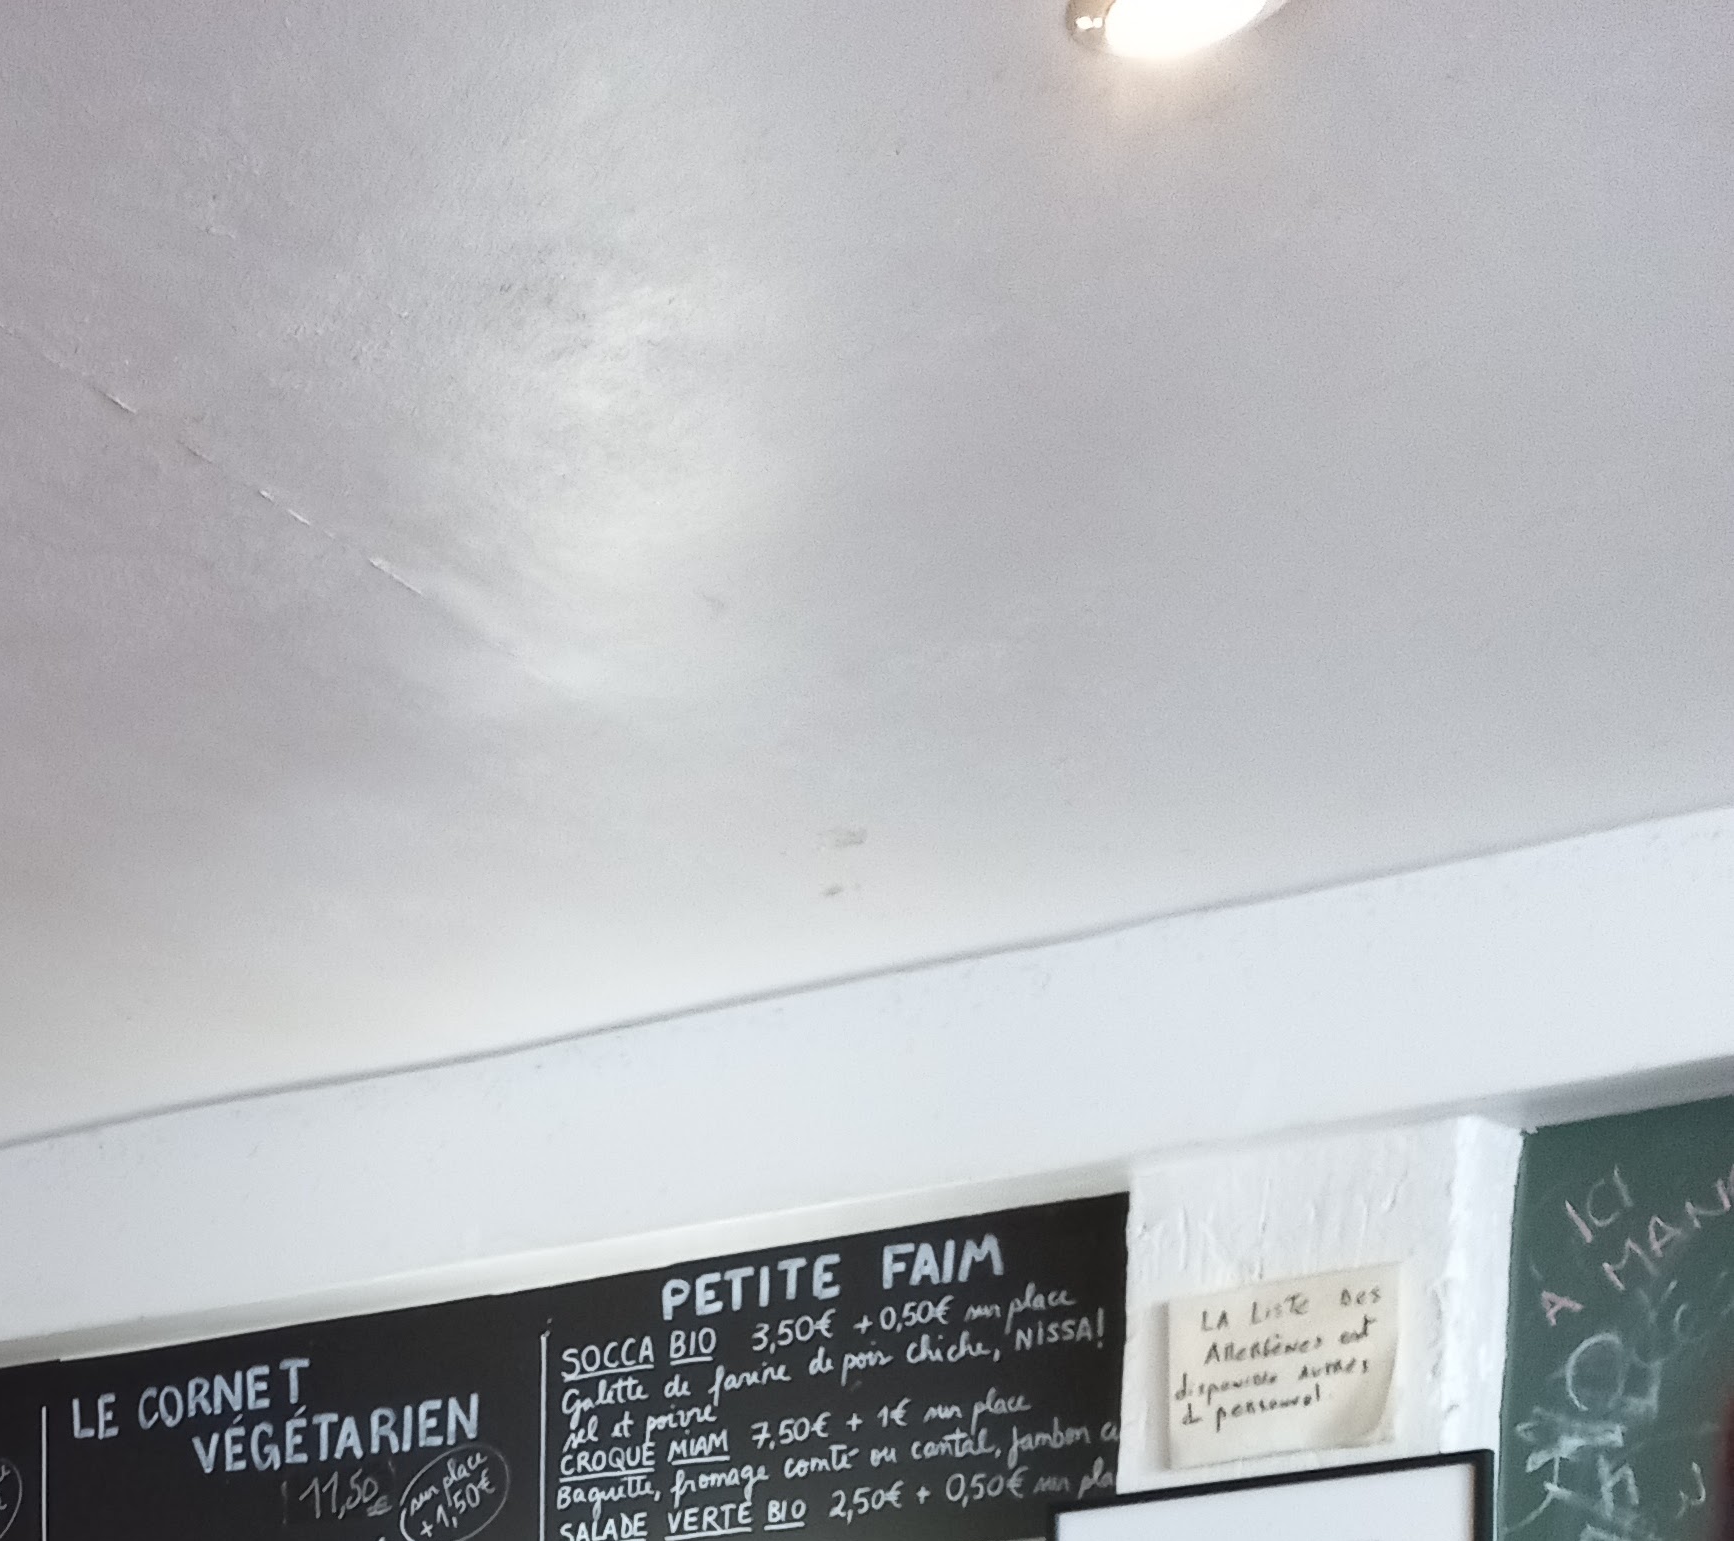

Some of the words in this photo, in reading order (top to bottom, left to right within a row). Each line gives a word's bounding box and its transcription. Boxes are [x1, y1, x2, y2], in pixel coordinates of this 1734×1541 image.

[662, 1254, 840, 1320] PETITE
[883, 1235, 1003, 1289] FAIM
[561, 1336, 654, 1378] SOCCA
[670, 1328, 716, 1358] BIO
[753, 1309, 835, 1358] 3,50€
[73, 1394, 118, 1439] LE
[139, 1359, 309, 1434] CORNET
[192, 1393, 480, 1473] VÉGÉTARIEN
[560, 1438, 655, 1479] CROQUE
[667, 1429, 730, 1465] MIAM
[751, 1412, 830, 1449] 7,50€
[665, 1499, 752, 1538] VERTE
[768, 1500, 806, 1522] BIO
